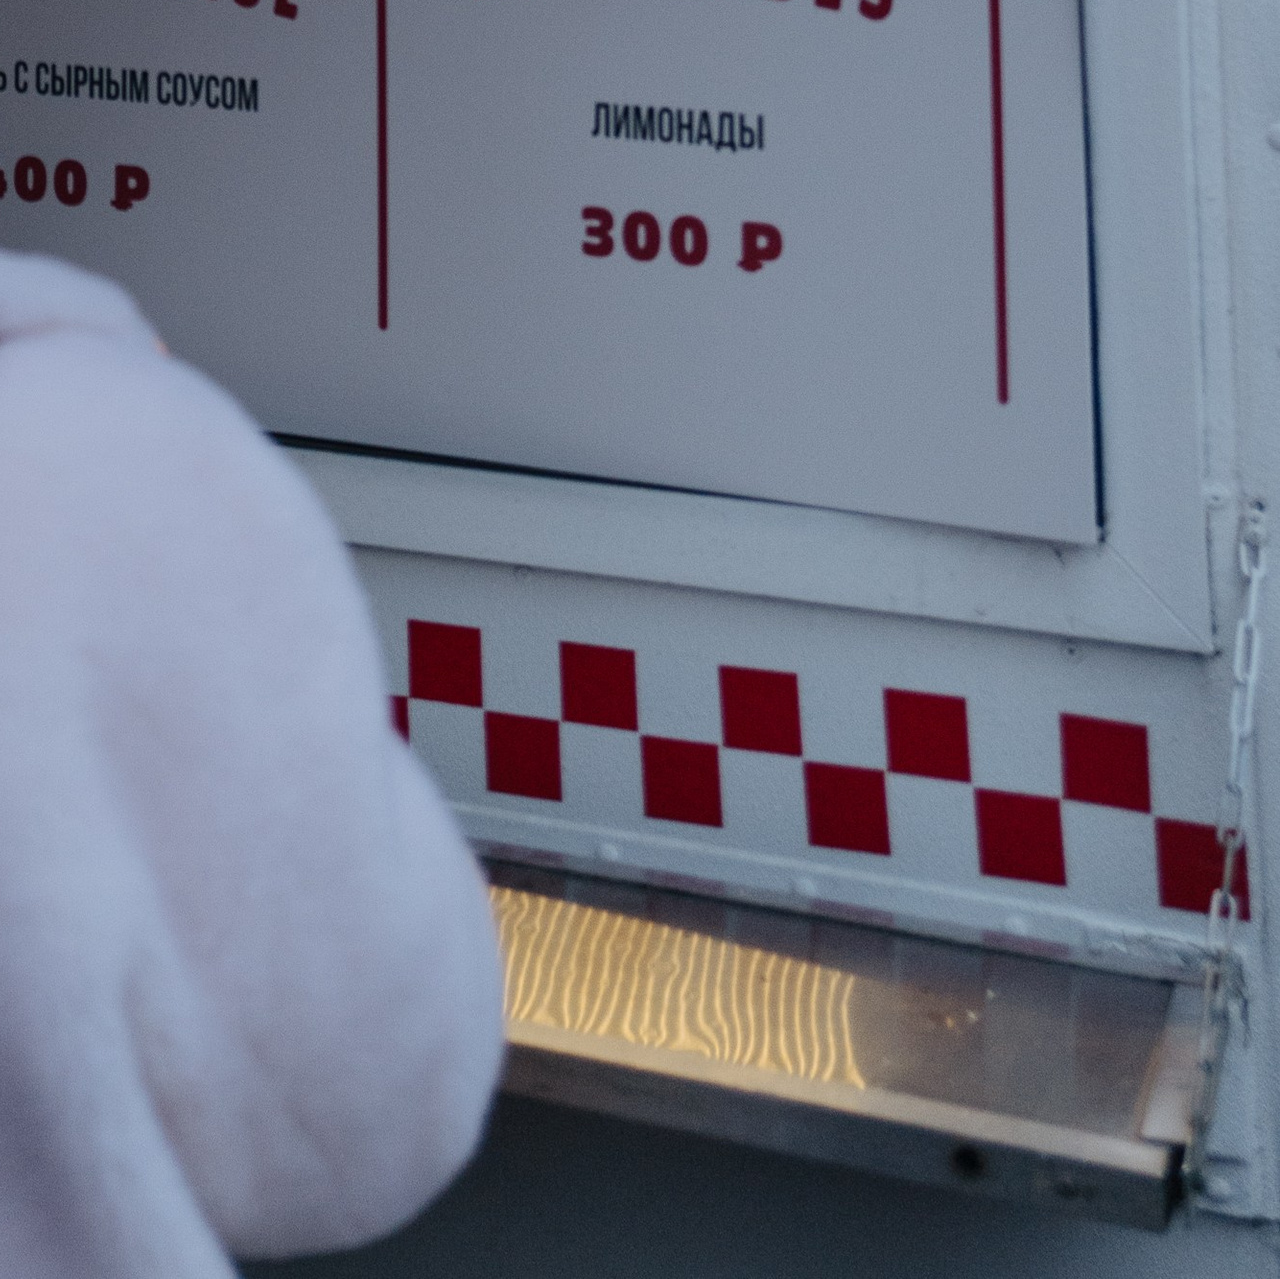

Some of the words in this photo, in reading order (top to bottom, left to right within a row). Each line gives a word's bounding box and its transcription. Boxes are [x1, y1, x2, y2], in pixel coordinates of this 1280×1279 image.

[35, 62, 149, 104] СЫРНЫМ
[156, 70, 259, 112] СОУСОМ
[590, 101, 765, 153] ЛИМОНАДЫ
[580, 206, 709, 267] 300
